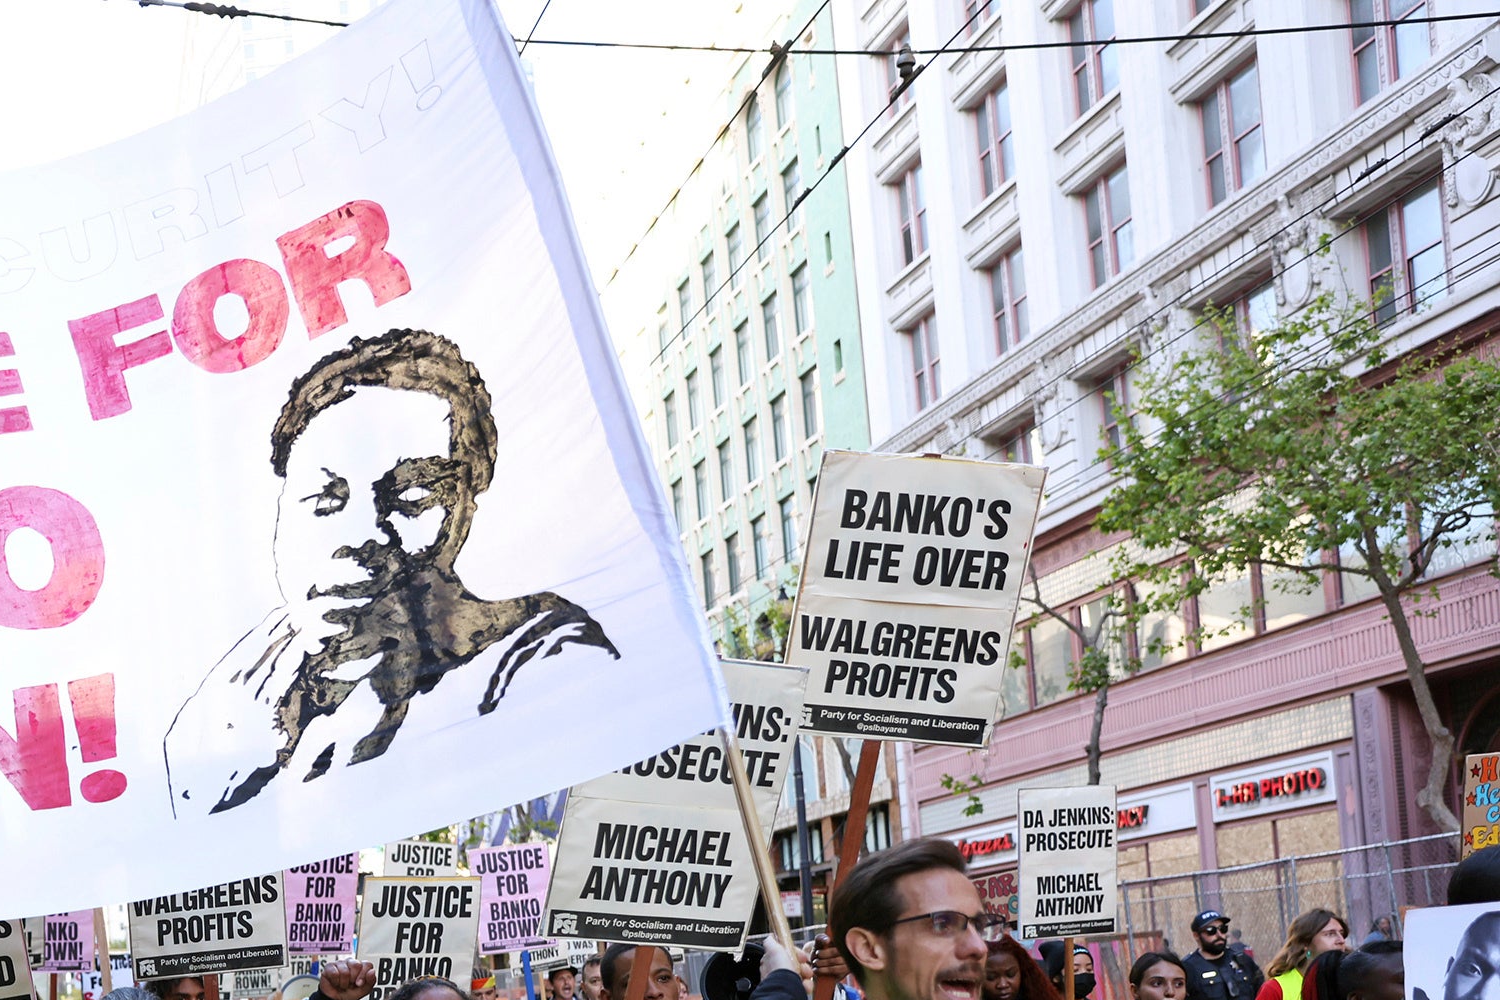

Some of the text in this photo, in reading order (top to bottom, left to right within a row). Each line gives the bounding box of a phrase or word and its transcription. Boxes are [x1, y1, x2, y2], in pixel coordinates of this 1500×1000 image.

[67, 199, 412, 421] FOR
[840, 488, 1012, 540] BANKO'S
[824, 539, 1010, 591] LIFE OVER
[800, 614, 1001, 666] WALGREENS
[824, 659, 958, 704] PROFITS
[820, 709, 846, 720] Party
[847, 711, 861, 720] for
[863, 712, 908, 725] Socialism
[911, 717, 930, 727] and
[932, 719, 980, 731] Liberation
[857, 722, 908, 734] @pslbayarea
[1260, 767, 1323, 798] PHOTO
[1024, 810, 1044, 828] DA
[1049, 806, 1114, 827] JENKINS:
[593, 822, 733, 868] MICHAEL
[958, 833, 1013, 861] lgreens
[1026, 829, 1113, 852] PROSECUTE
[391, 844, 452, 866] JUSTICE
[476, 848, 543, 874] JUSTICE
[305, 876, 335, 898] FOR
[496, 873, 529, 897] FOR
[580, 866, 733, 908] ANTHONY
[1037, 873, 1102, 895] MICHAEL
[295, 903, 342, 922] BANKO
[372, 886, 473, 918] JUSTICE
[490, 898, 540, 921] BANKO
[1035, 895, 1104, 917] ANTHONY
[157, 910, 254, 946] PROFITS
[289, 923, 345, 942] BROWN!
[553, 914, 740, 935] PSL Party for Socialism and Liberation
[622, 930, 672, 940] @pslbayarea
[395, 922, 444, 954] FOR
[139, 960, 159, 977] PSL
[160, 958, 178, 966] Party
[192, 954, 226, 963] Socialism
[227, 952, 241, 960] and
[242, 949, 279, 958] Liberation
[189, 961, 227, 971] @pslbayarea
[235, 974, 272, 991] ROWN!
